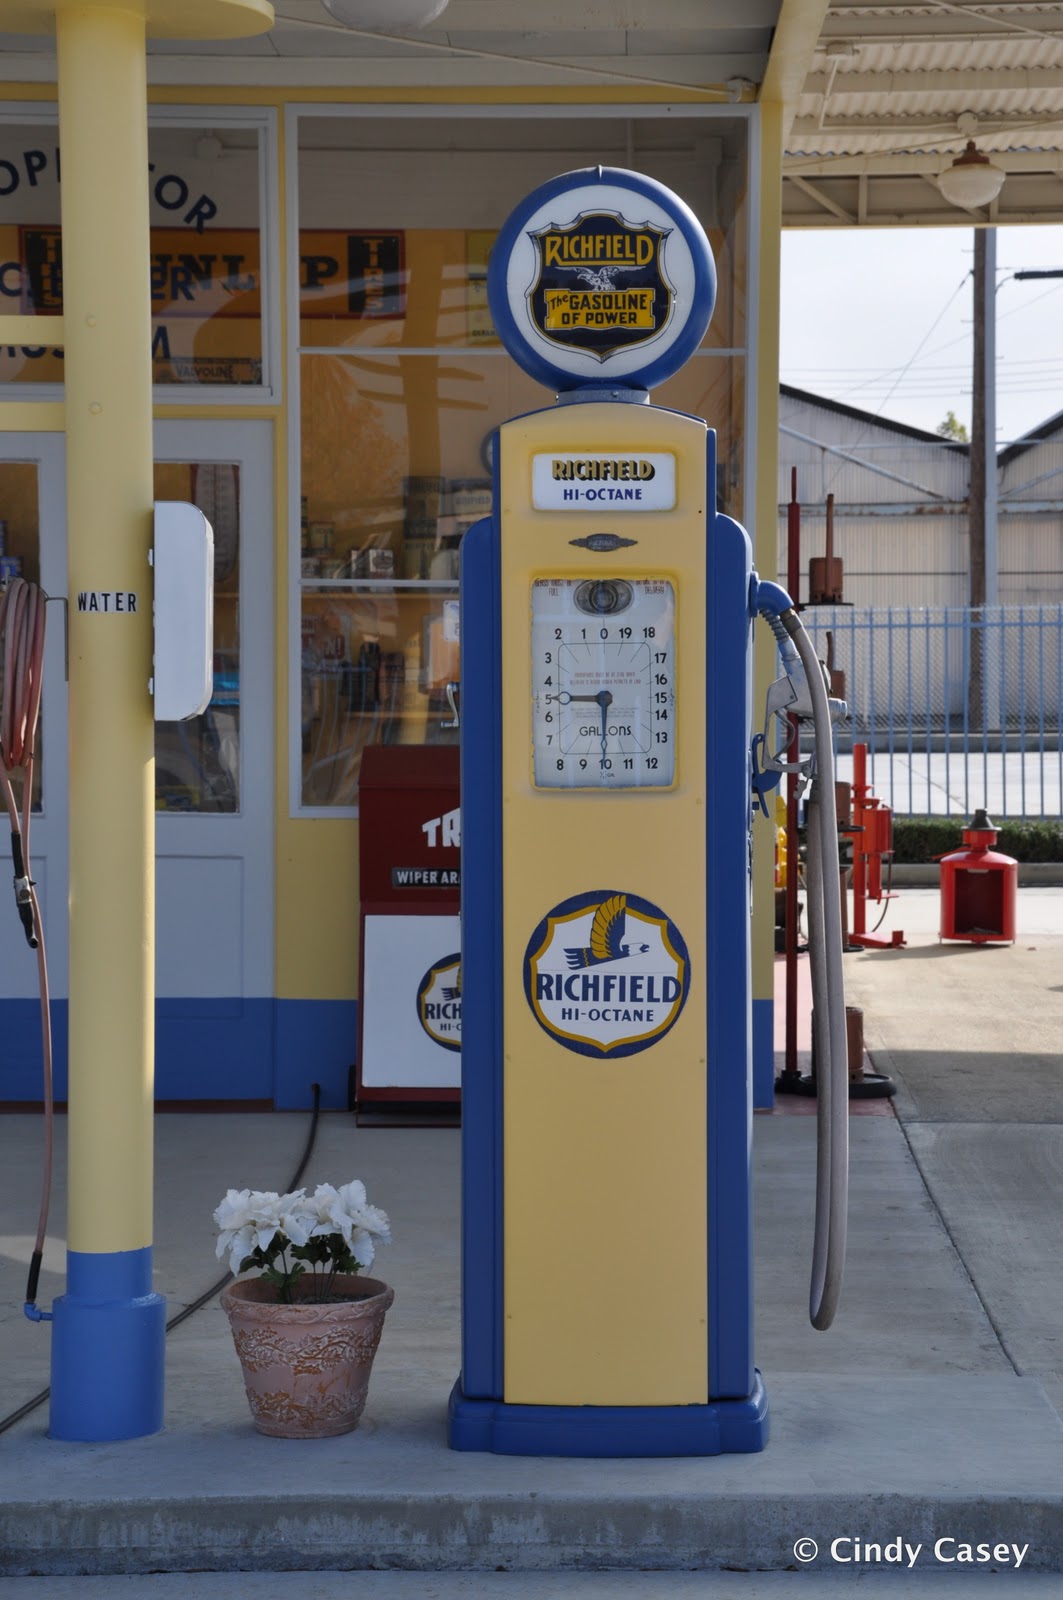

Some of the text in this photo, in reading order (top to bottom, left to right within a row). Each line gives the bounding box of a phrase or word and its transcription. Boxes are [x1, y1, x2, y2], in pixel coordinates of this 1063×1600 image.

[545, 235, 654, 266] RICHFIELD
[550, 294, 648, 310] The GASOLINE
[561, 312, 637, 325] OF POWER
[552, 459, 655, 481] RICHFIELD
[563, 488, 642, 501] HI-OCTANE
[77, 592, 137, 612] WATER
[555, 627, 655, 639] 2 1 0 19 18
[545, 652, 552, 664] 3
[654, 652, 667, 664] 17
[544, 676, 552, 686] 4
[654, 674, 668, 685] 16
[545, 694, 552, 705] 5
[654, 692, 668, 703] 15
[545, 711, 553, 722] 6
[655, 709, 668, 720] 14
[546, 735, 553, 745] 7
[655, 732, 668, 743] 13
[556, 758, 658, 770] 8 9 10 11 12
[396, 871, 461, 884] WIPER AR
[536, 973, 682, 1003] RICHFIELD
[561, 1008, 654, 1022] HI-OCTANE
